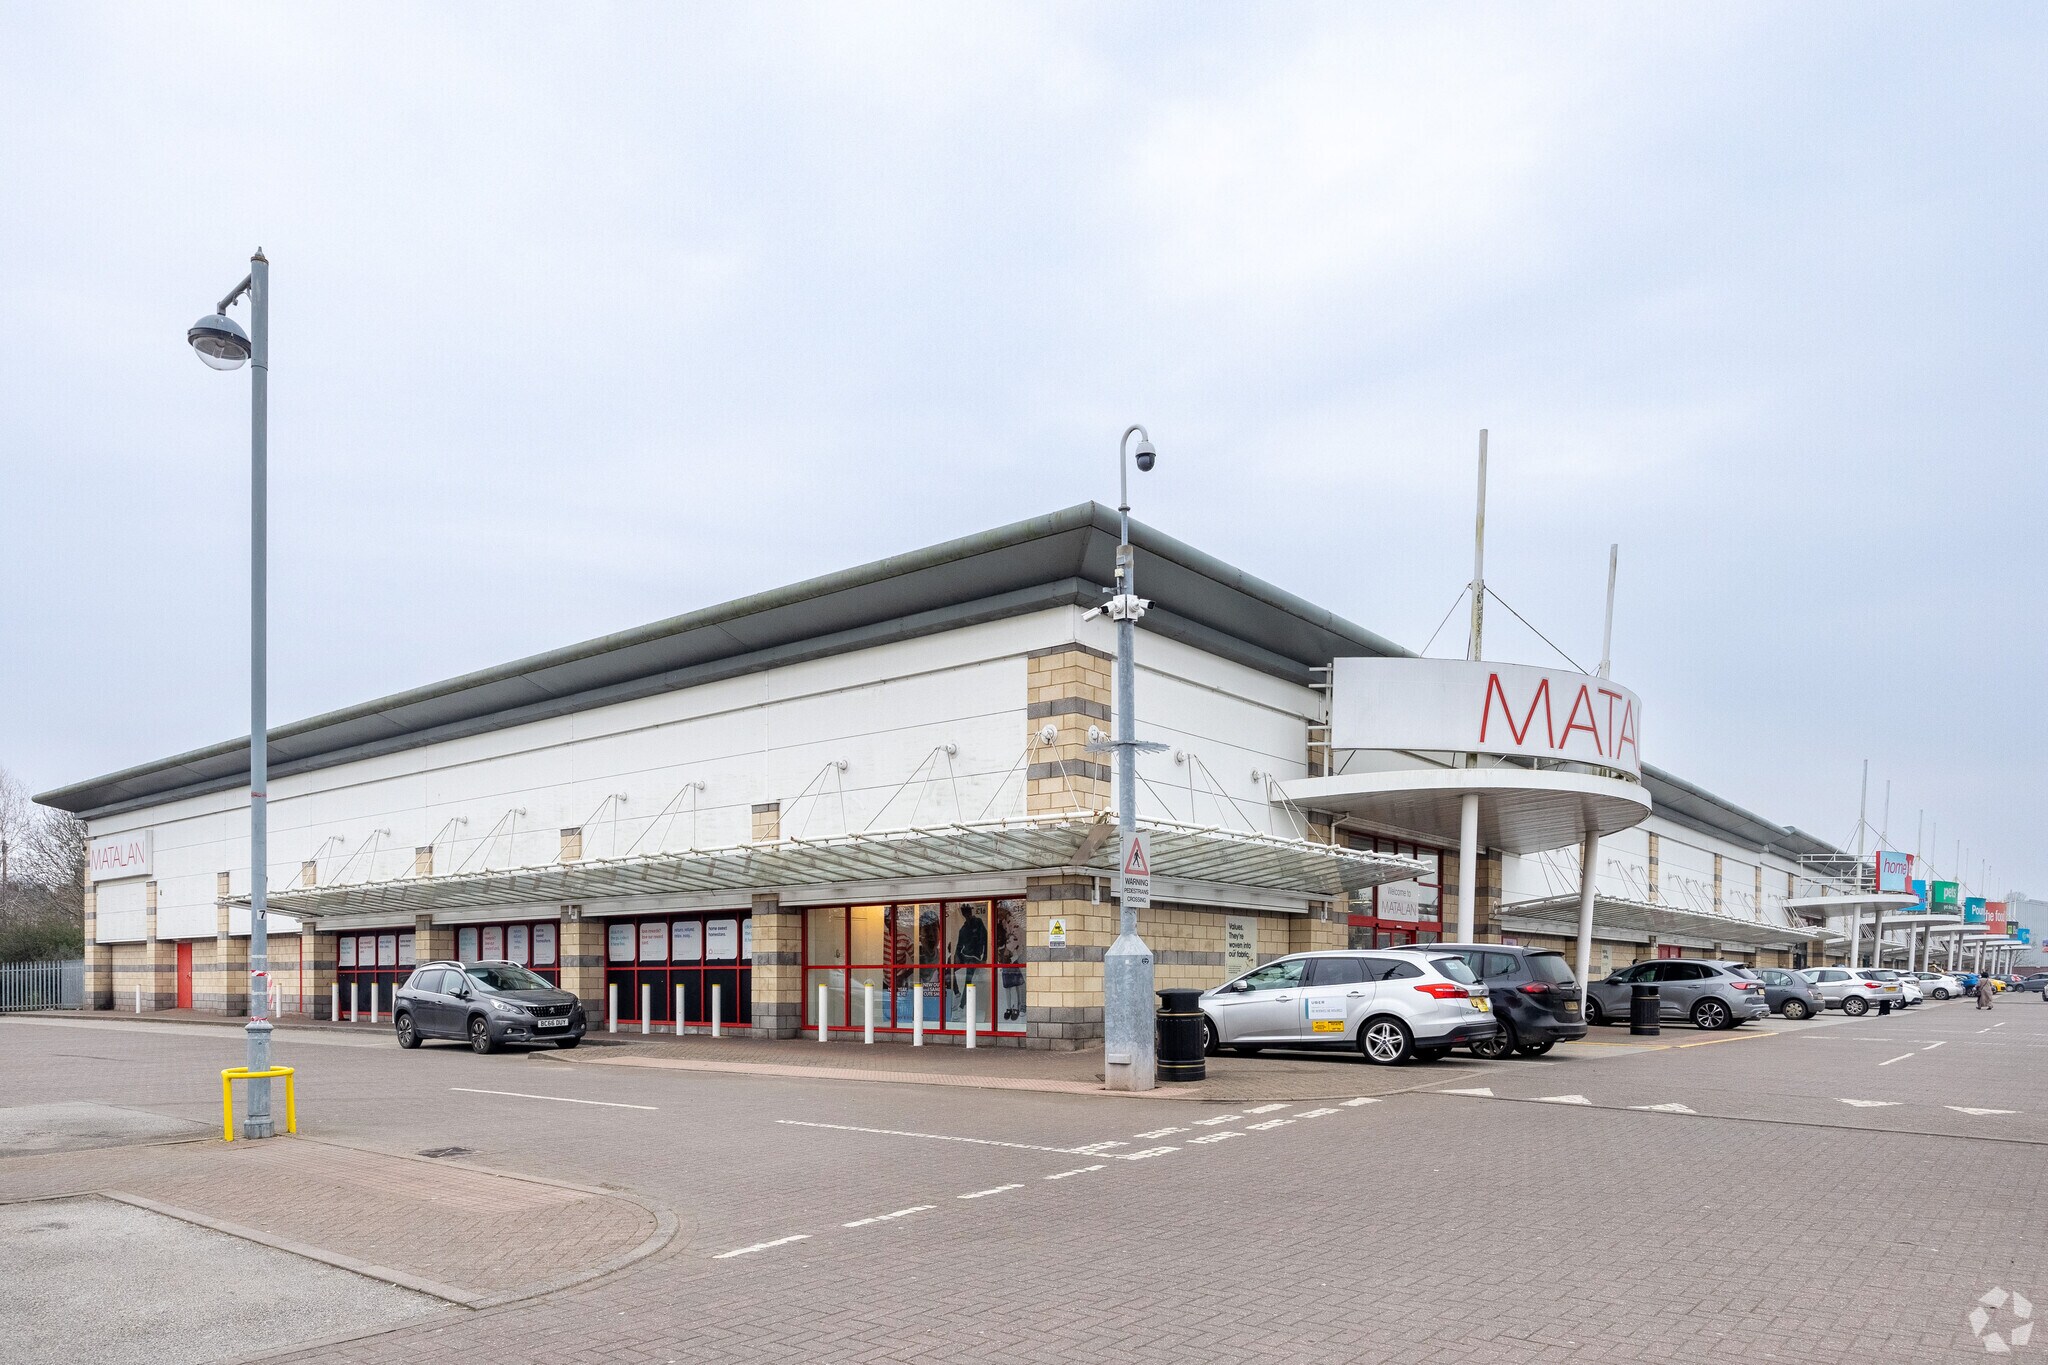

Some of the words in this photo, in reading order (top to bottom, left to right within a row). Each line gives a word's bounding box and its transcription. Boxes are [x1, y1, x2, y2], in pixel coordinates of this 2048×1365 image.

[90, 840, 145, 871] MATALAN
[1883, 858, 1907, 875] home
[1124, 877, 1149, 887] WARNING
[1387, 886, 1406, 897] Welcome
[1406, 890, 1412, 898] to
[1381, 900, 1417, 916] MATALAN
[259, 909, 266, 920] 7
[1228, 931, 1244, 941] They're
[1243, 942, 1251, 950] into
[1228, 950, 1236, 958] our
